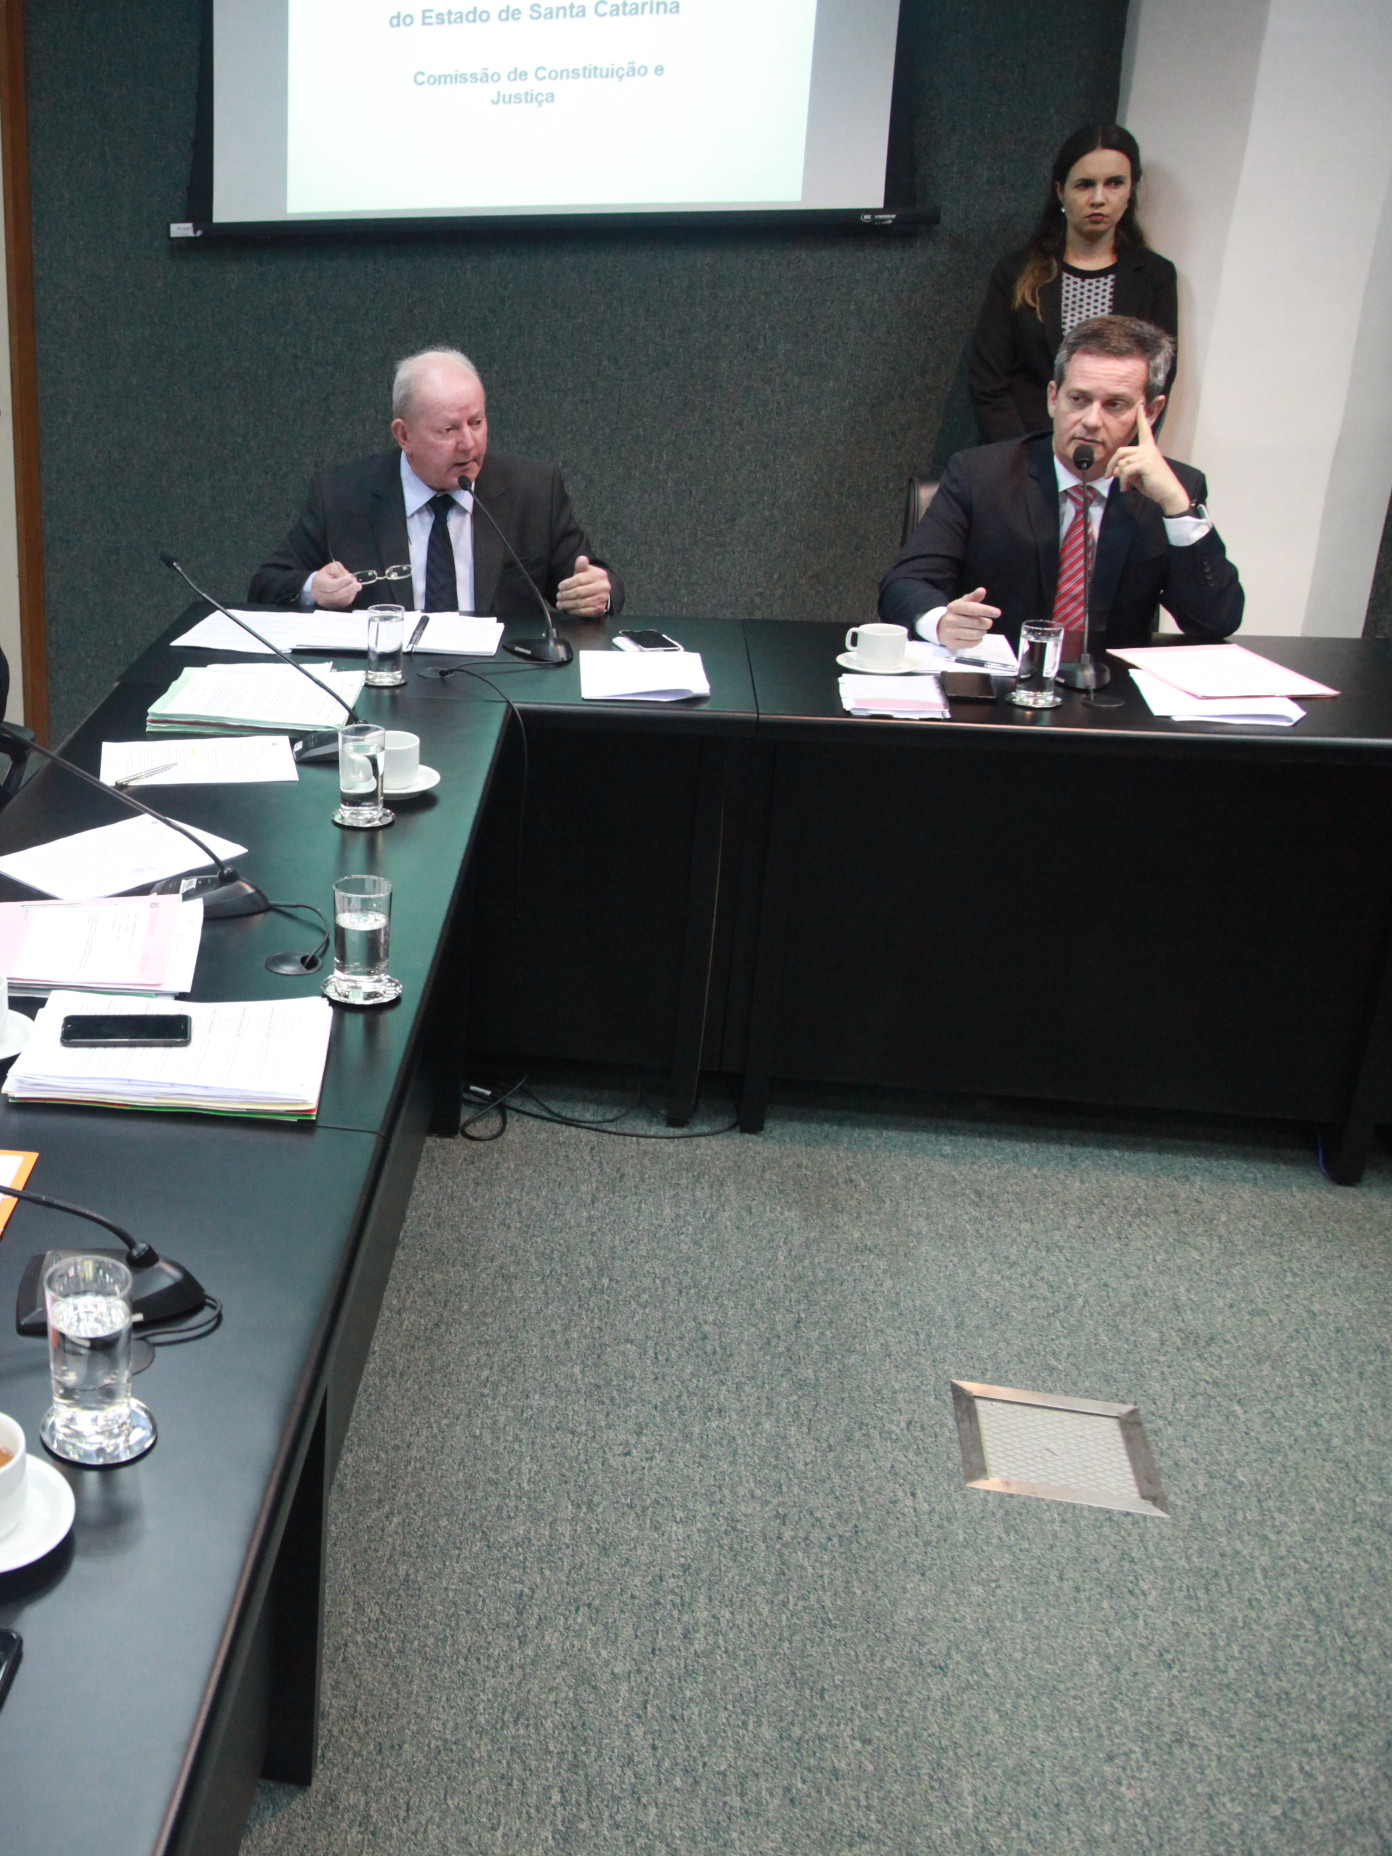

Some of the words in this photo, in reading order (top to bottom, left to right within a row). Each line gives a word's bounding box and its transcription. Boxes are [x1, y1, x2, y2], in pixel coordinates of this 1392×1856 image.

[389, 11, 414, 28] do
[421, 5, 491, 26] Estado
[497, 5, 522, 22] de
[528, 3, 587, 20] Santa
[593, 0, 681, 18] Catarina
[413, 68, 501, 86] Comissão
[507, 67, 528, 82] de
[534, 62, 649, 82] Constituição
[654, 64, 665, 76] e
[490, 89, 555, 108] Justiça
